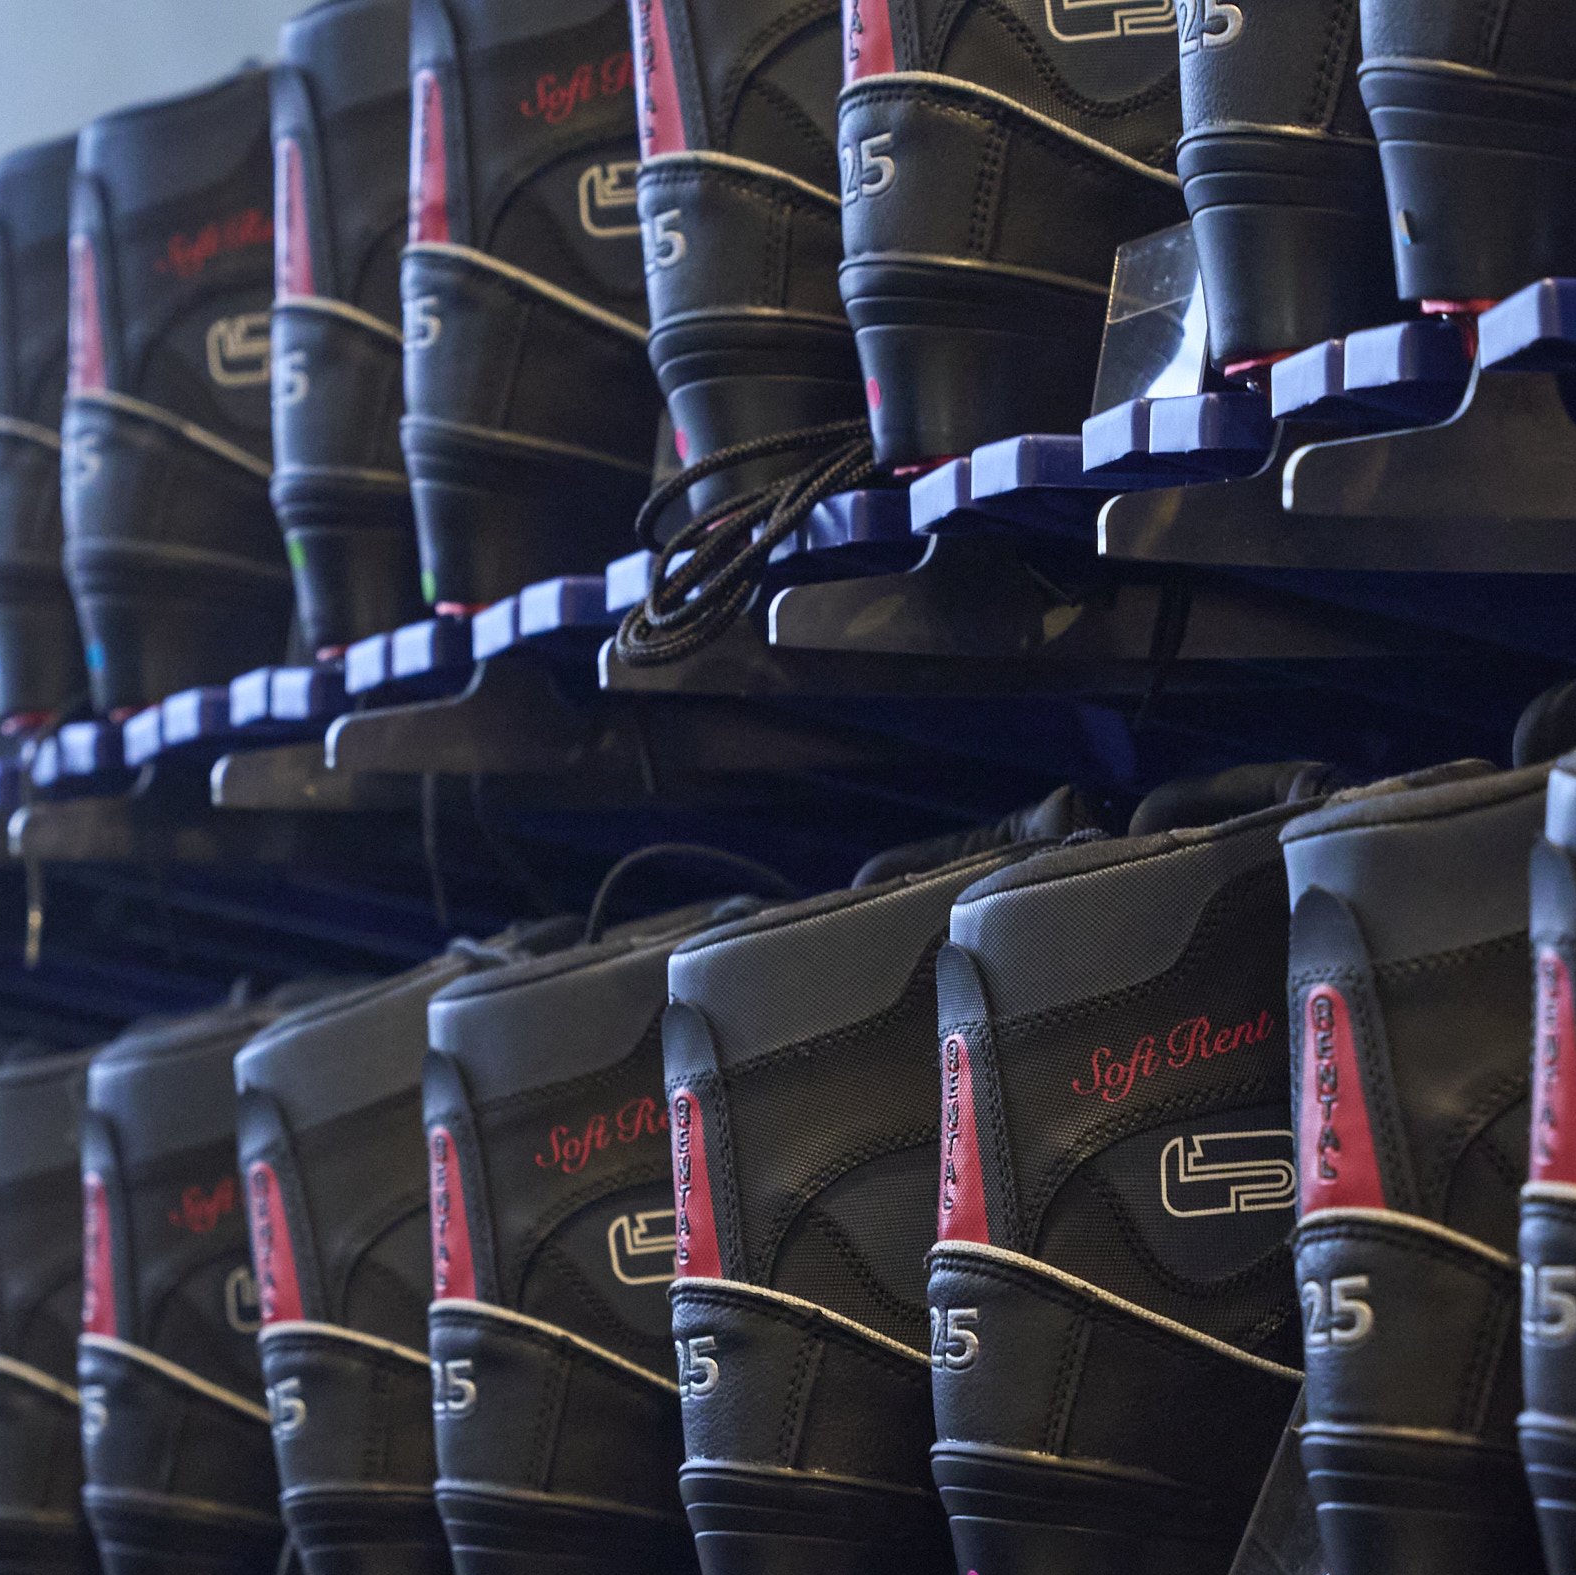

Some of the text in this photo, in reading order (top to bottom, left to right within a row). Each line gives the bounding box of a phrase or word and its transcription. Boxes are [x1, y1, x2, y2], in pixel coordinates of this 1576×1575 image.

[840, 131, 897, 207] 25
[1071, 1009, 1274, 1103] Soft Rent
[1311, 995, 1342, 1185] RENTAL
[535, 1114, 607, 1173] Soft
[942, 1038, 959, 1215] RENTAL
[675, 1096, 692, 1265] RENTAL
[1301, 1274, 1375, 1348] 25
